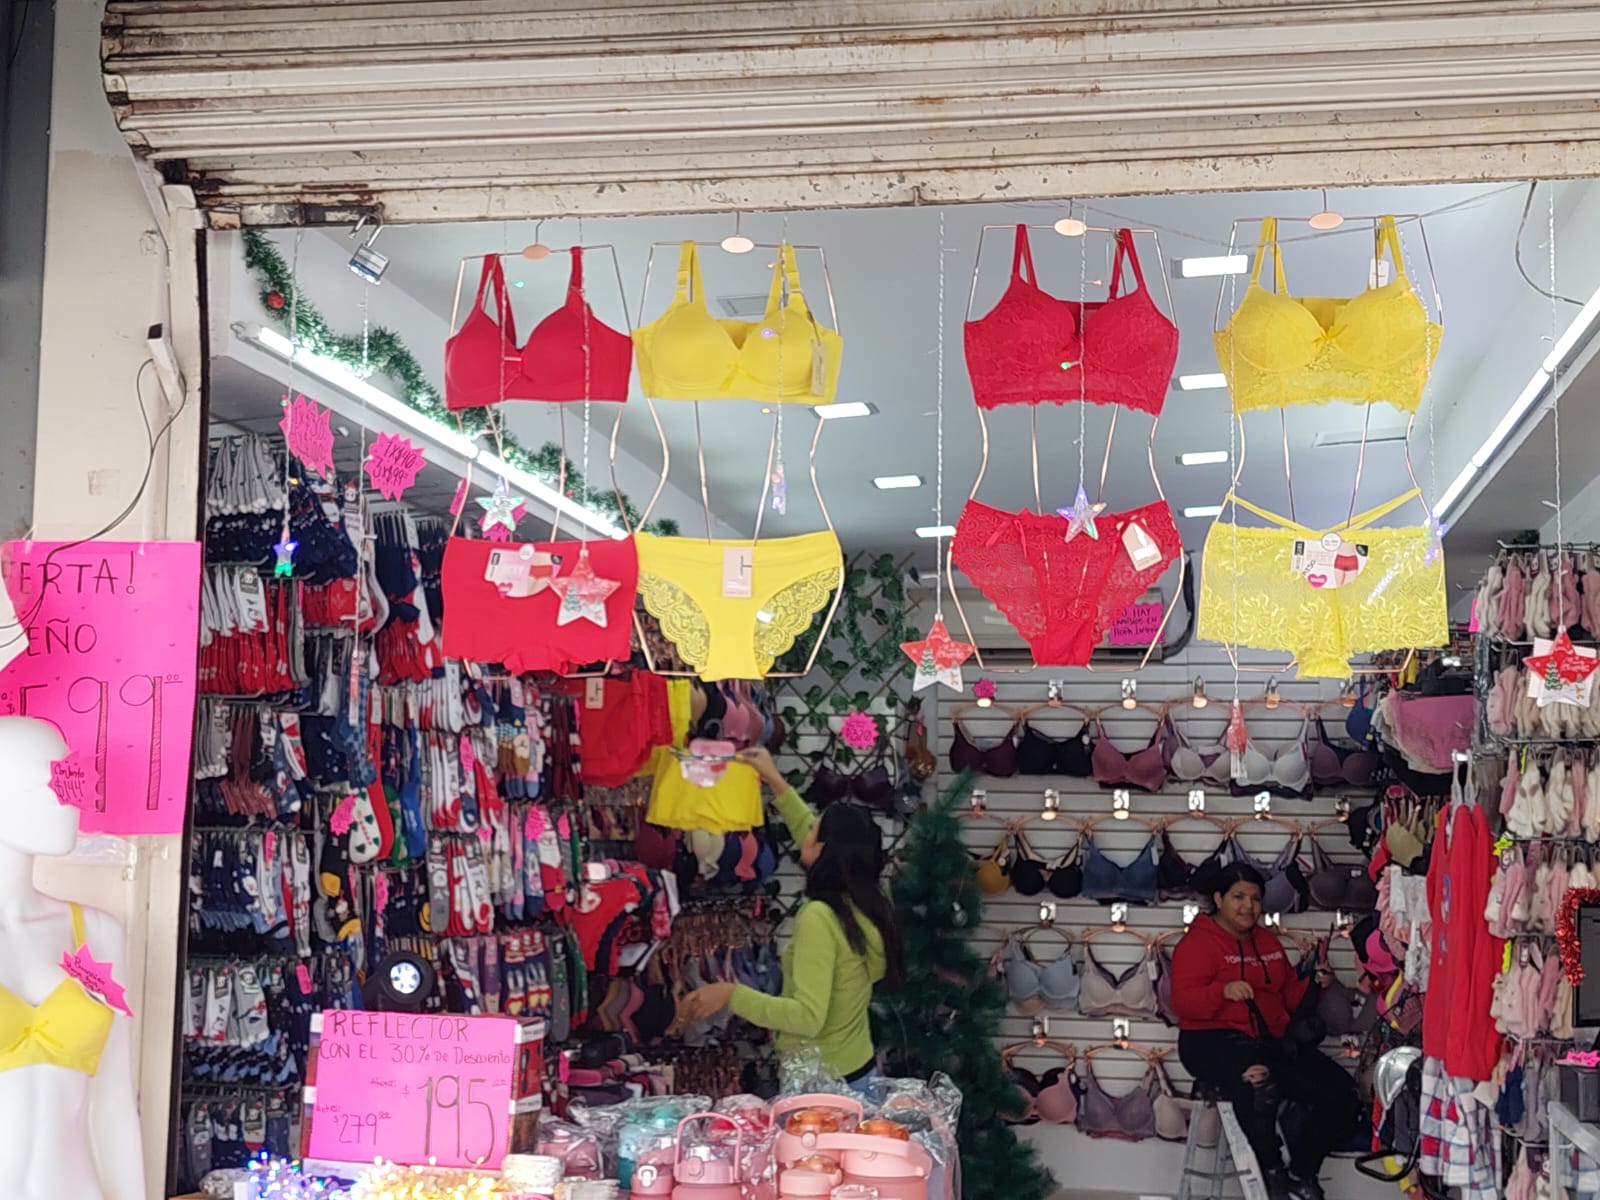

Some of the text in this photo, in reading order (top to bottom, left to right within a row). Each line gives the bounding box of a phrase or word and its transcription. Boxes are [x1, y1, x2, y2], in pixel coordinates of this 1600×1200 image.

[26, 617, 97, 657] EÑO
[329, 1010, 470, 1042] REFLECTOR
[318, 1038, 351, 1060] CON
[359, 1043, 378, 1060] EL
[391, 1041, 431, 1064] 30%
